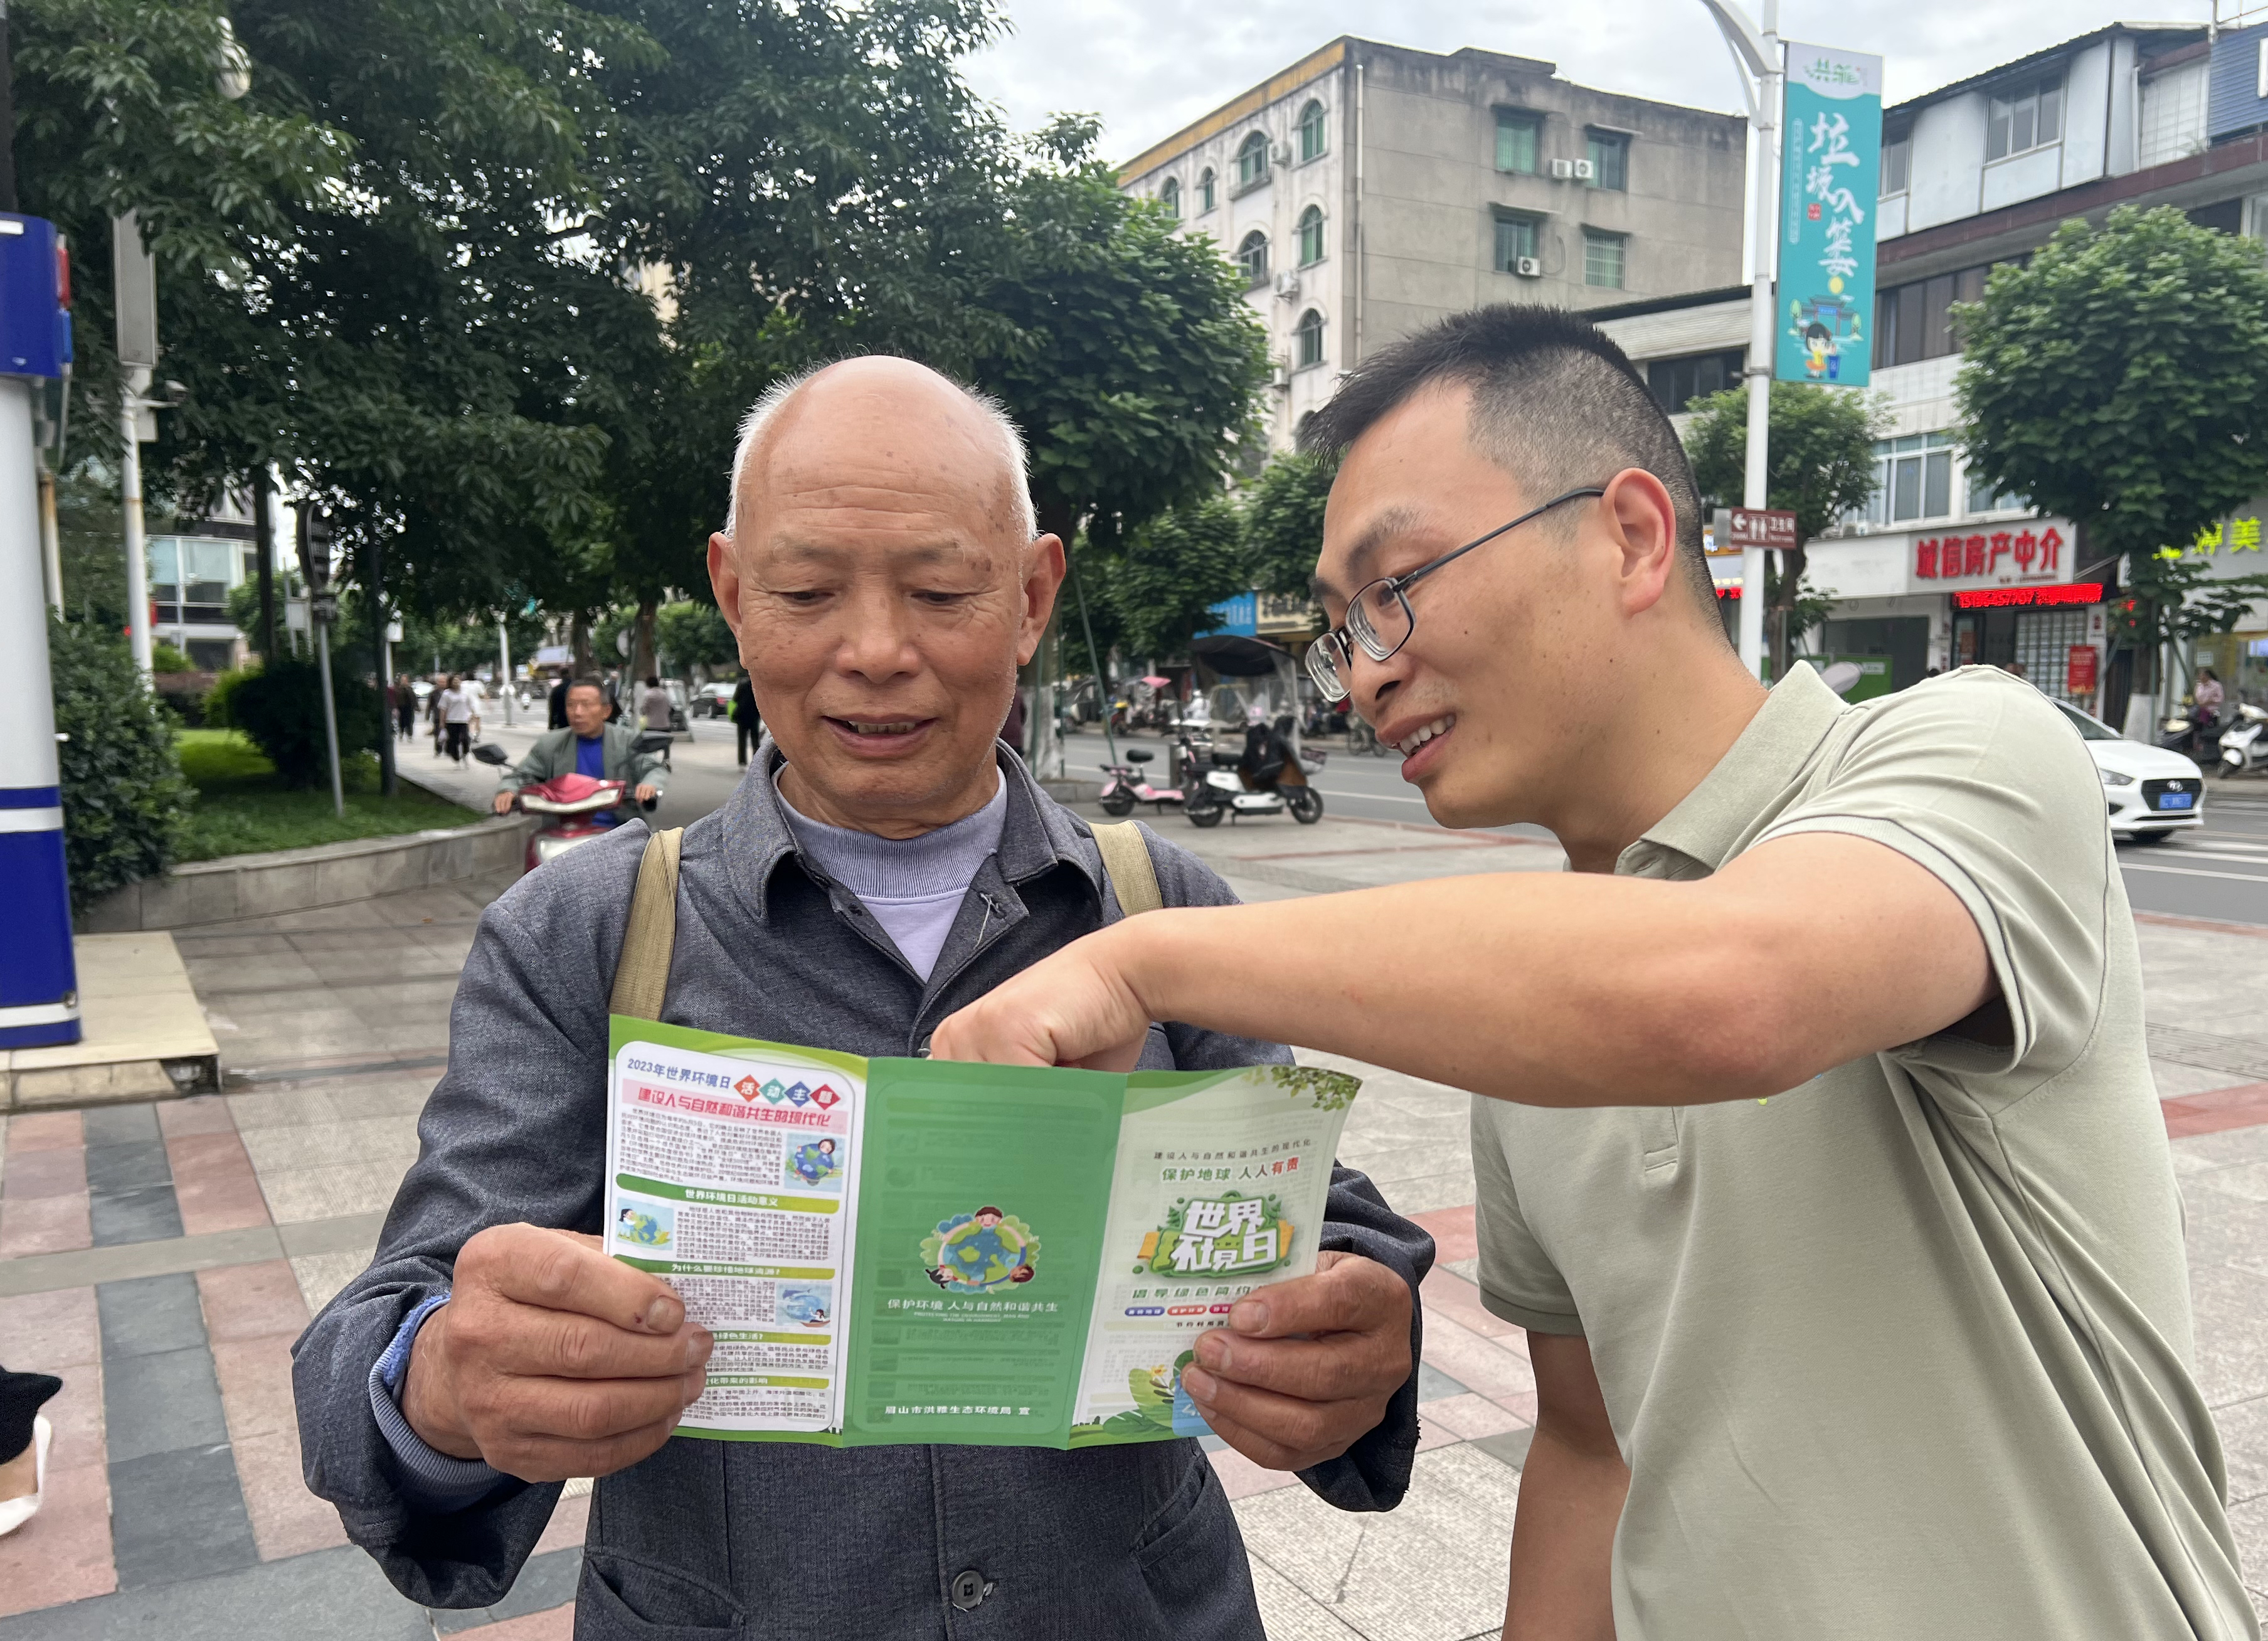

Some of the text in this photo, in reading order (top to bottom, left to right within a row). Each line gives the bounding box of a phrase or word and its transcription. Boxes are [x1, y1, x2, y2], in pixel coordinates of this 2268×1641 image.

[1770, 516, 1795, 533] 卫生间
[627, 1058, 834, 1104] 2023年世界环境日 活动主题
[637, 1086, 832, 1127] 建设人与自然和谐共生的现代化
[1154, 1139, 1312, 1160] 建设人与自然和谐共生的现代化
[1162, 1157, 1300, 1182] 保护地球 人人有责
[685, 1189, 778, 1207] 世界环境日活动意义
[1184, 1198, 1265, 1238] 世界
[1170, 1229, 1278, 1271] 环境日
[1132, 1284, 1267, 1299] 倡导绿色简约
[887, 1298, 1059, 1314] 保护环境 人与自然和谐共生
[1176, 1320, 1230, 1329] 节约利用资
[885, 1405, 1031, 1416] 眉山市洪雅生态环境局 宣
